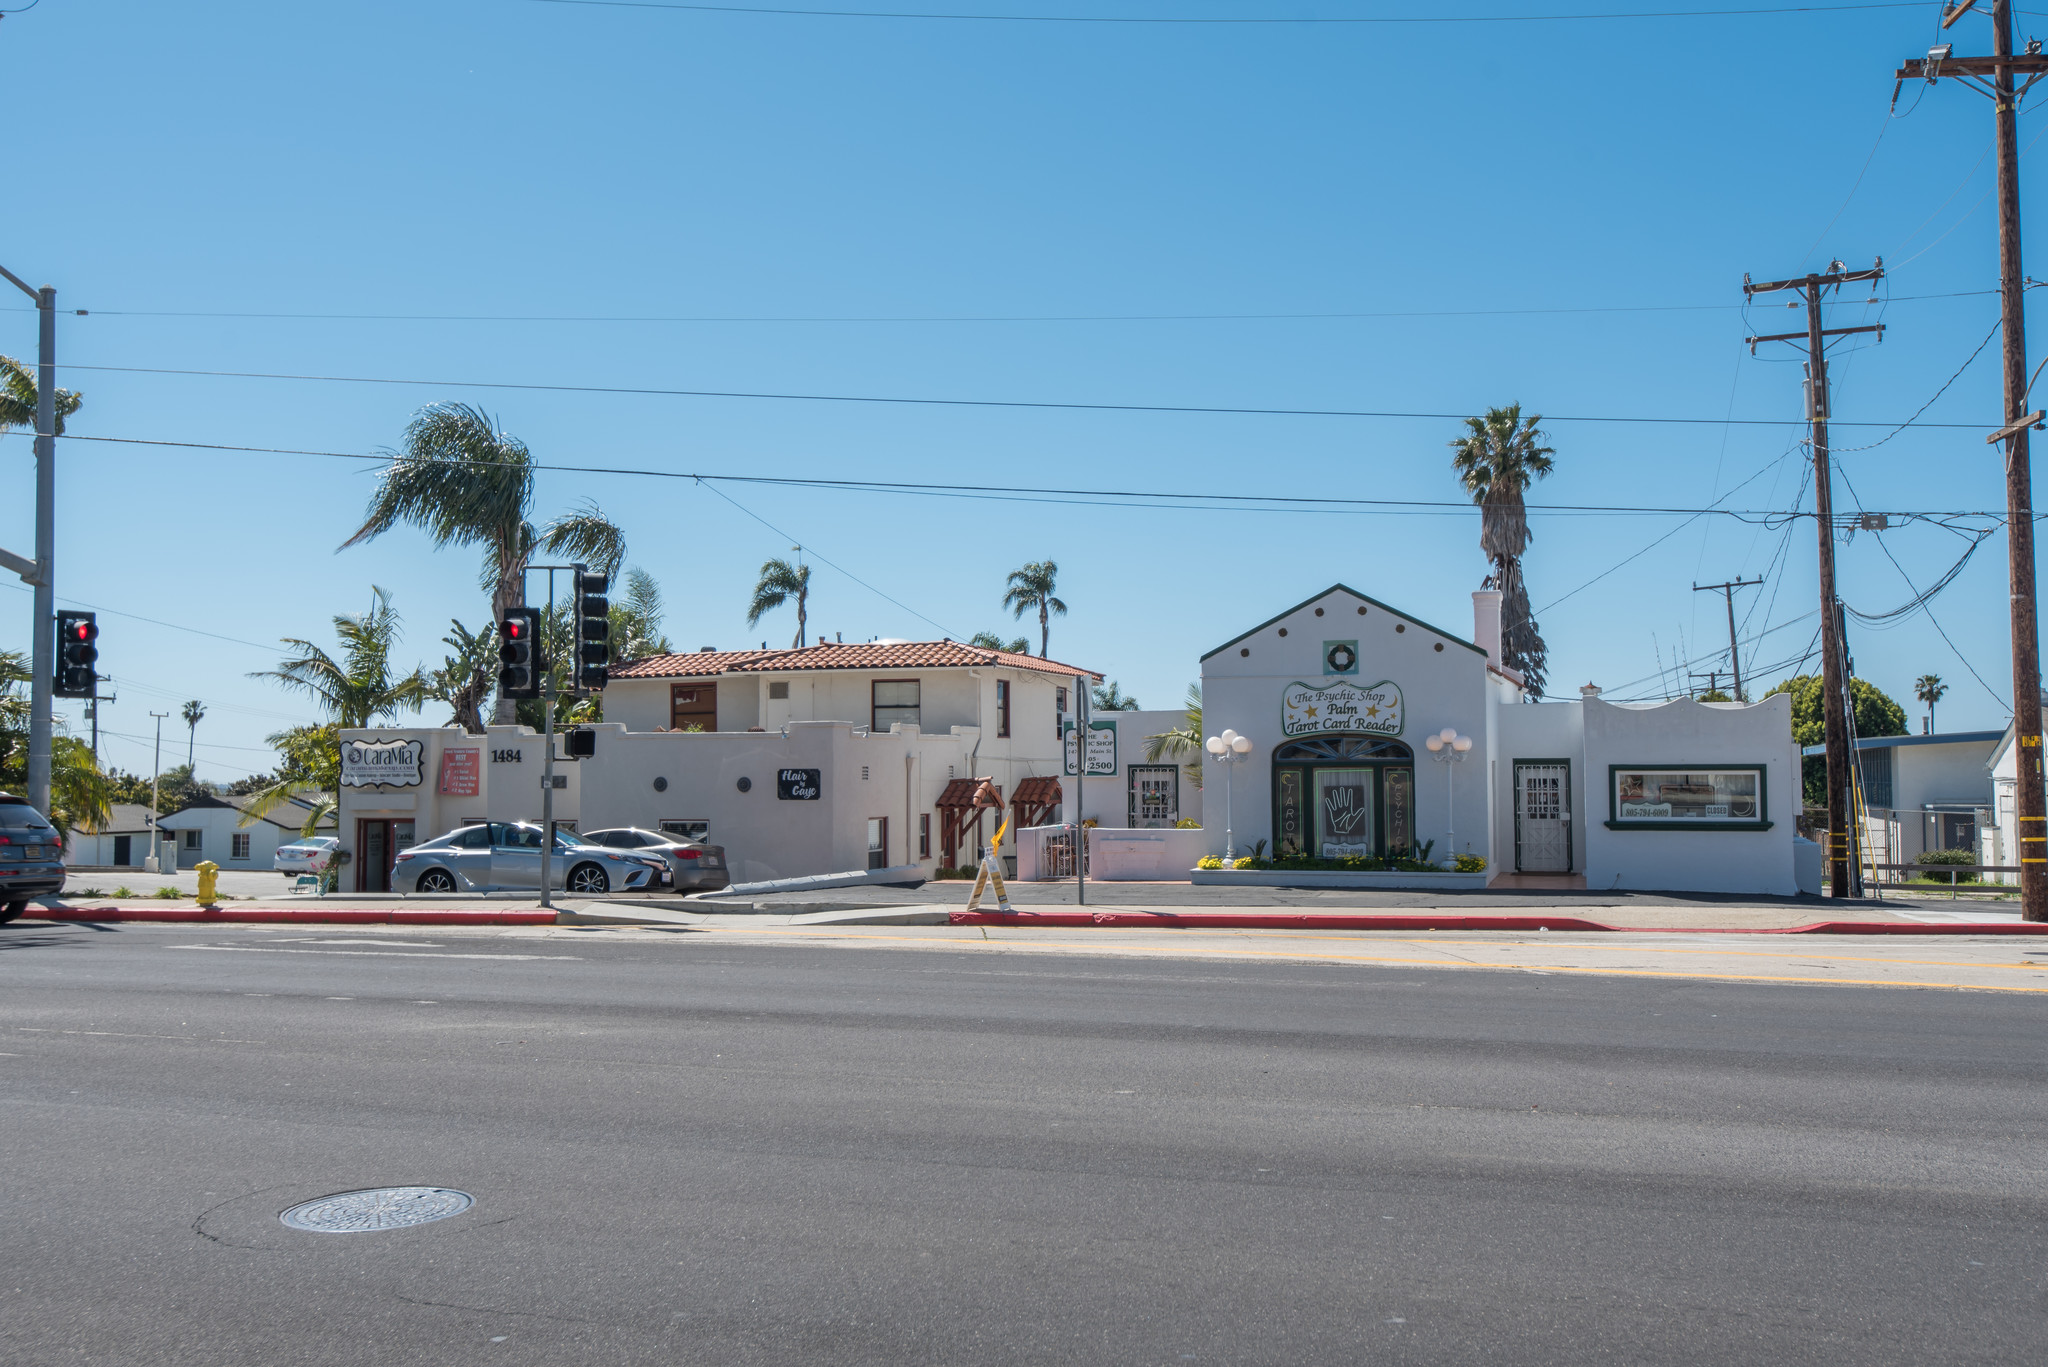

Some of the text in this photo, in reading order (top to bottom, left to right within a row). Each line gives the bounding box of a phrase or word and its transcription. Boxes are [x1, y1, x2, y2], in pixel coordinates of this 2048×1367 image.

[1295, 689, 1385, 705] The Psychic Shop
[1327, 701, 1358, 715] Palm
[1287, 715, 1398, 733] Tarot Card Reader
[491, 749, 522, 763] 1484
[782, 770, 807, 780] Hair
[792, 785, 817, 799] Gaye
[1285, 784, 1295, 842] TAROT
[1394, 784, 1403, 845] PSYCHIC
[1707, 806, 1727, 814] CLOSED
